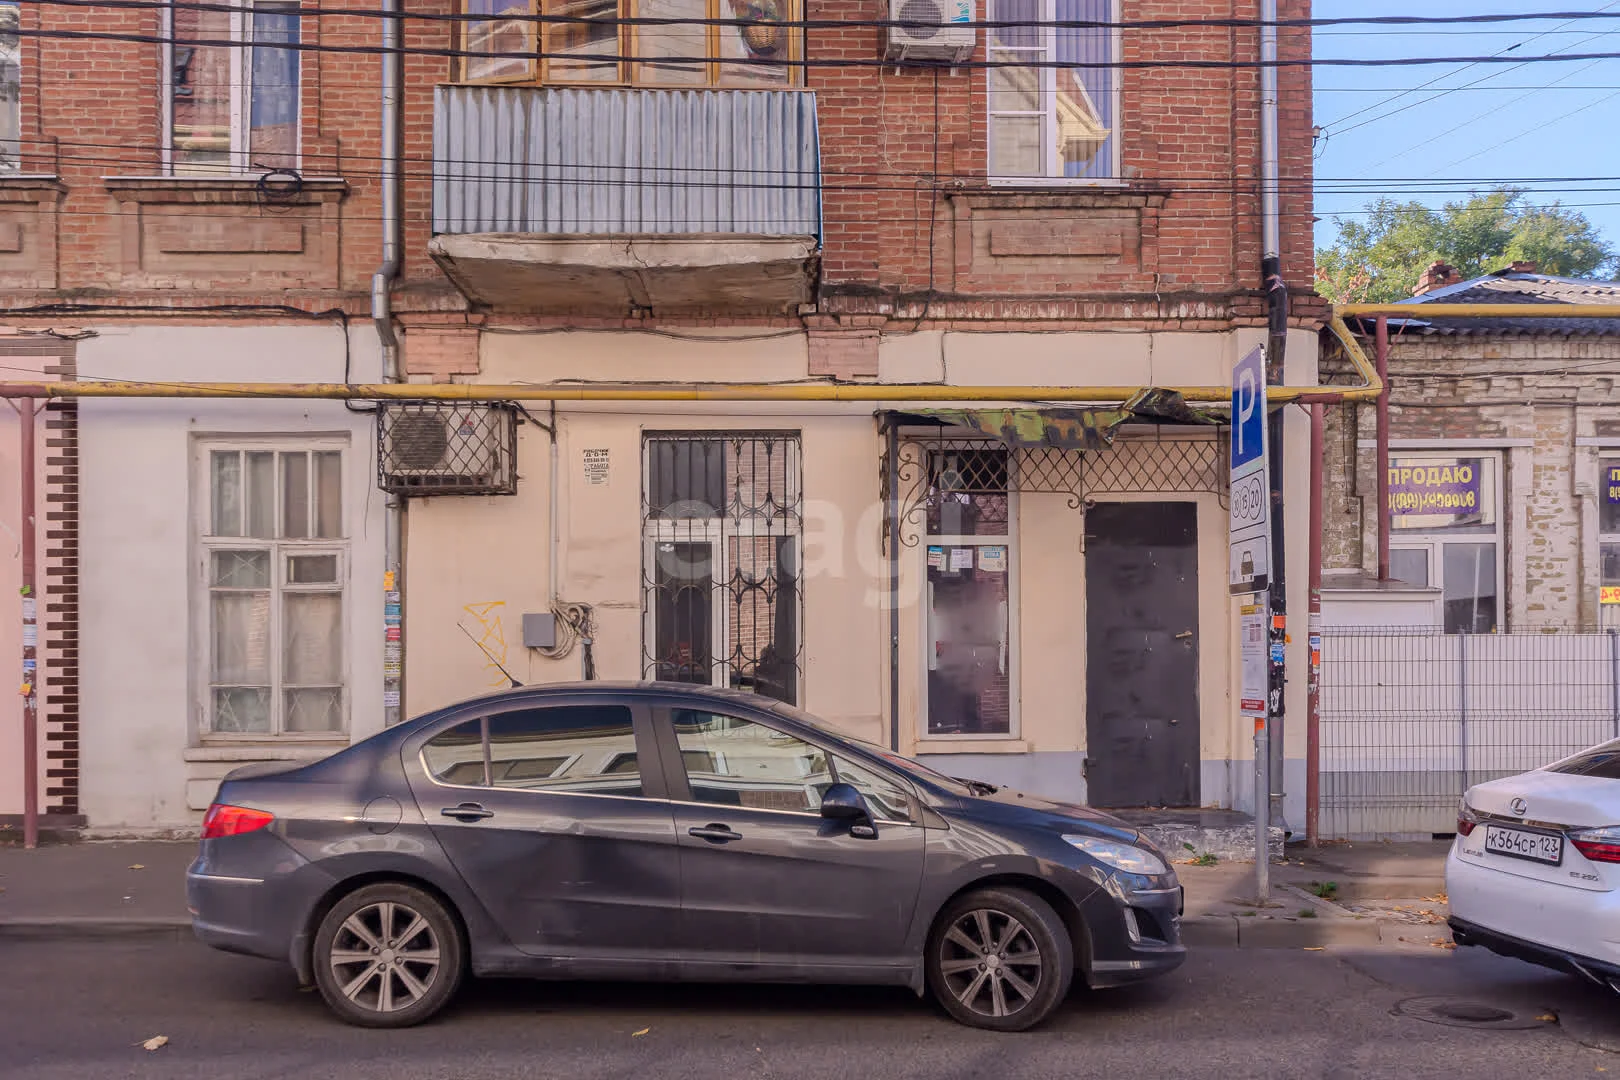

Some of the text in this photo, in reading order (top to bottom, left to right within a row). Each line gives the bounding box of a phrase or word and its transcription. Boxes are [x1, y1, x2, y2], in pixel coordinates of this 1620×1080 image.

[1238, 367, 1256, 455] P
[1387, 466, 1473, 488] ПРОДАЮ
[1250, 489, 1260, 509] 20
[1539, 836, 1556, 852] 123
